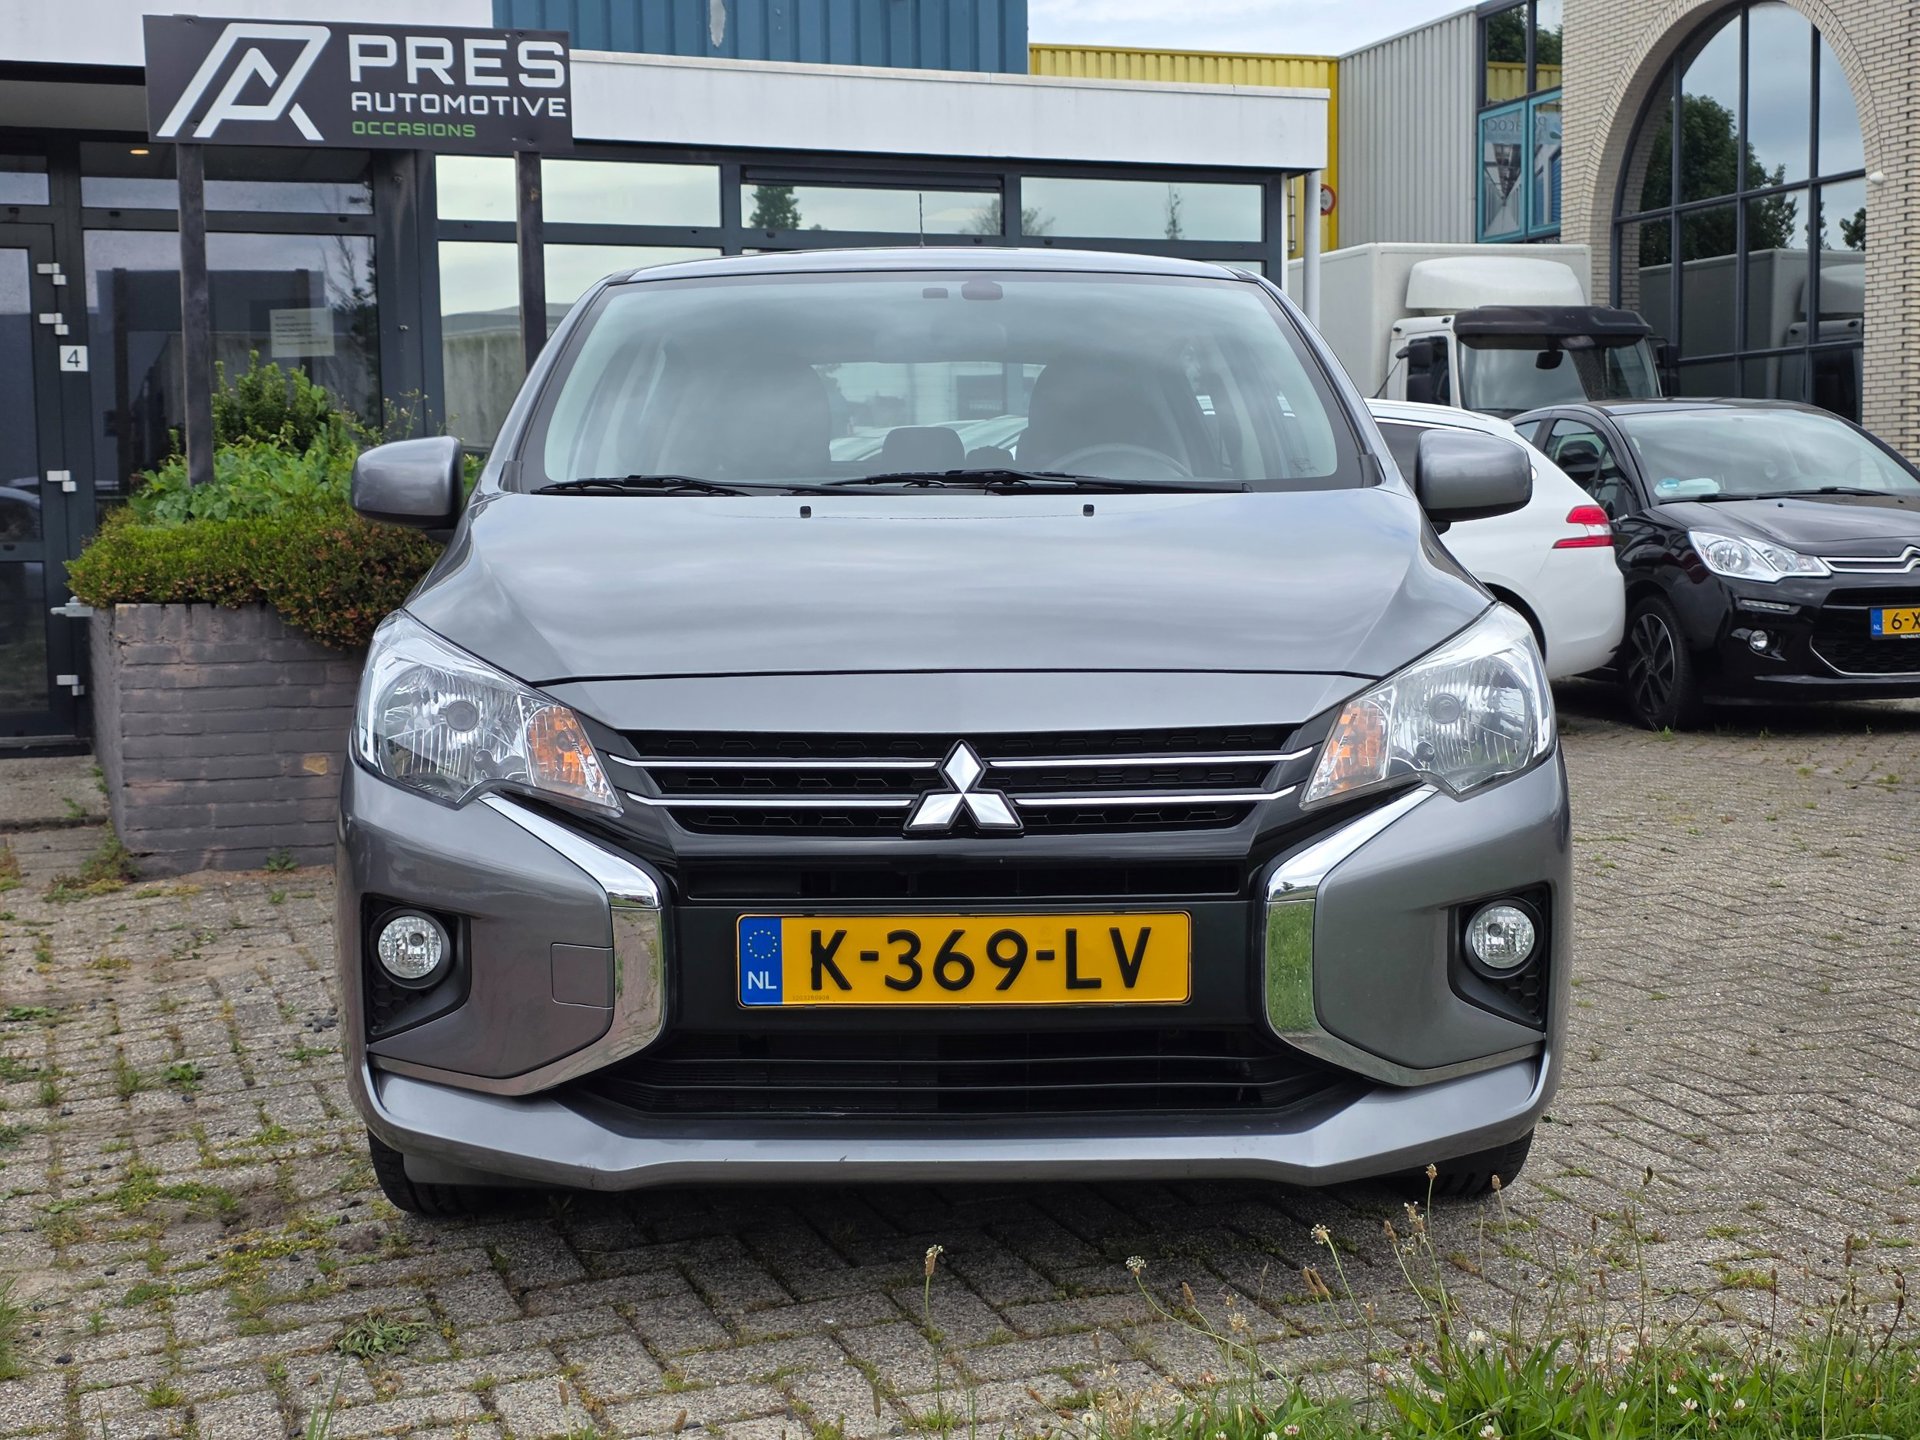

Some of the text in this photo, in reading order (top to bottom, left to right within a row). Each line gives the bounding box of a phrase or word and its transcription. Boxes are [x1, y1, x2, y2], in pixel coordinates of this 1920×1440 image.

[348, 34, 565, 88] PRES
[351, 91, 567, 118] AUTOMOTIVE
[352, 120, 477, 138] OCCASIONS
[66, 348, 81, 368] 4
[747, 926, 1152, 991] NL K-369-LV
